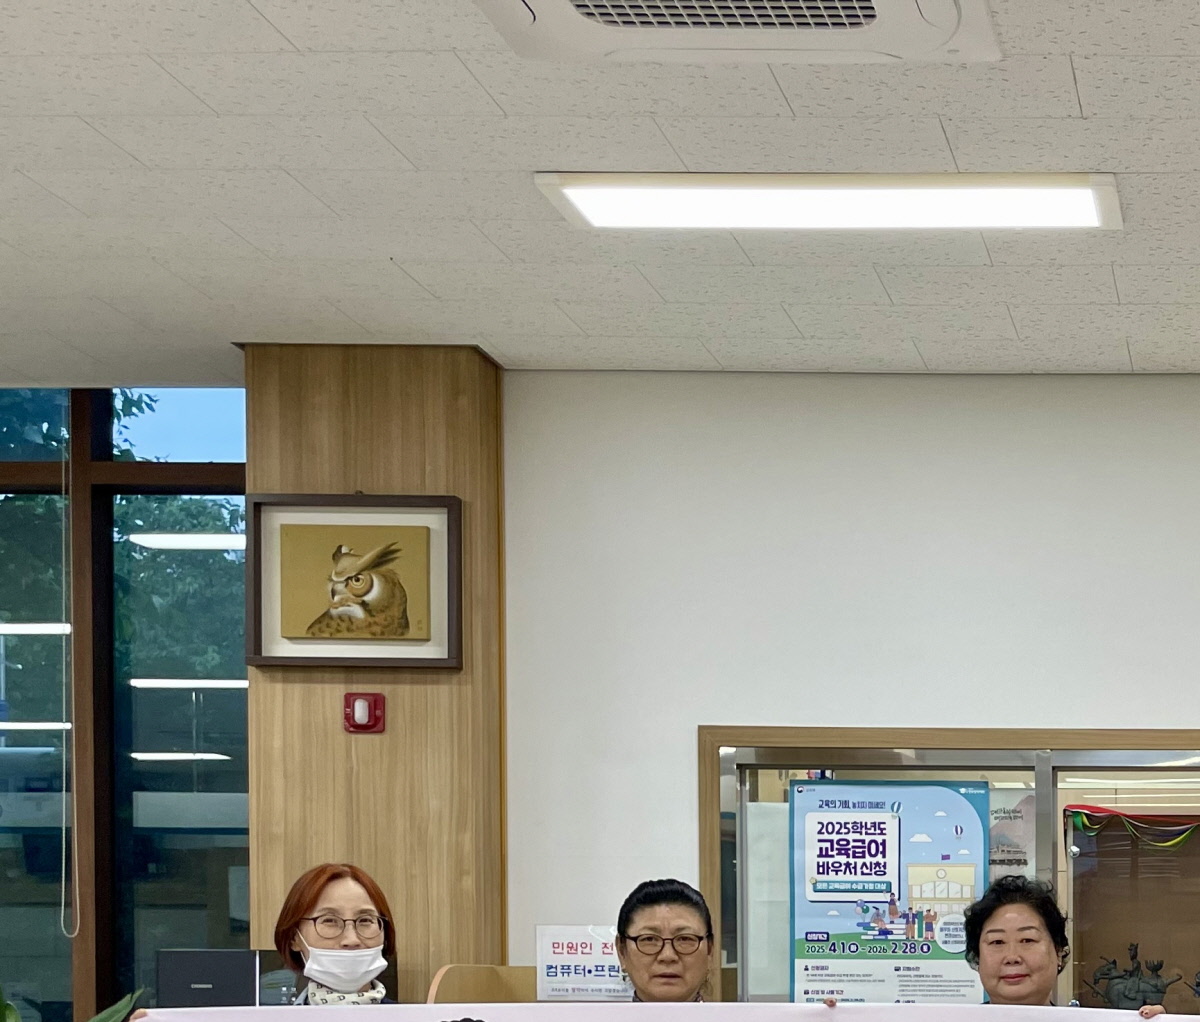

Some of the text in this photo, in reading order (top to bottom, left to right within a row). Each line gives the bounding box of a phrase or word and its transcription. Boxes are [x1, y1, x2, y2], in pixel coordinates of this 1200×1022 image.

[817, 821, 887, 835] 2025학년도
[817, 838, 886, 859] 교육급여
[817, 861, 887, 876] 바우처 신청
[552, 942, 592, 955] 민원인
